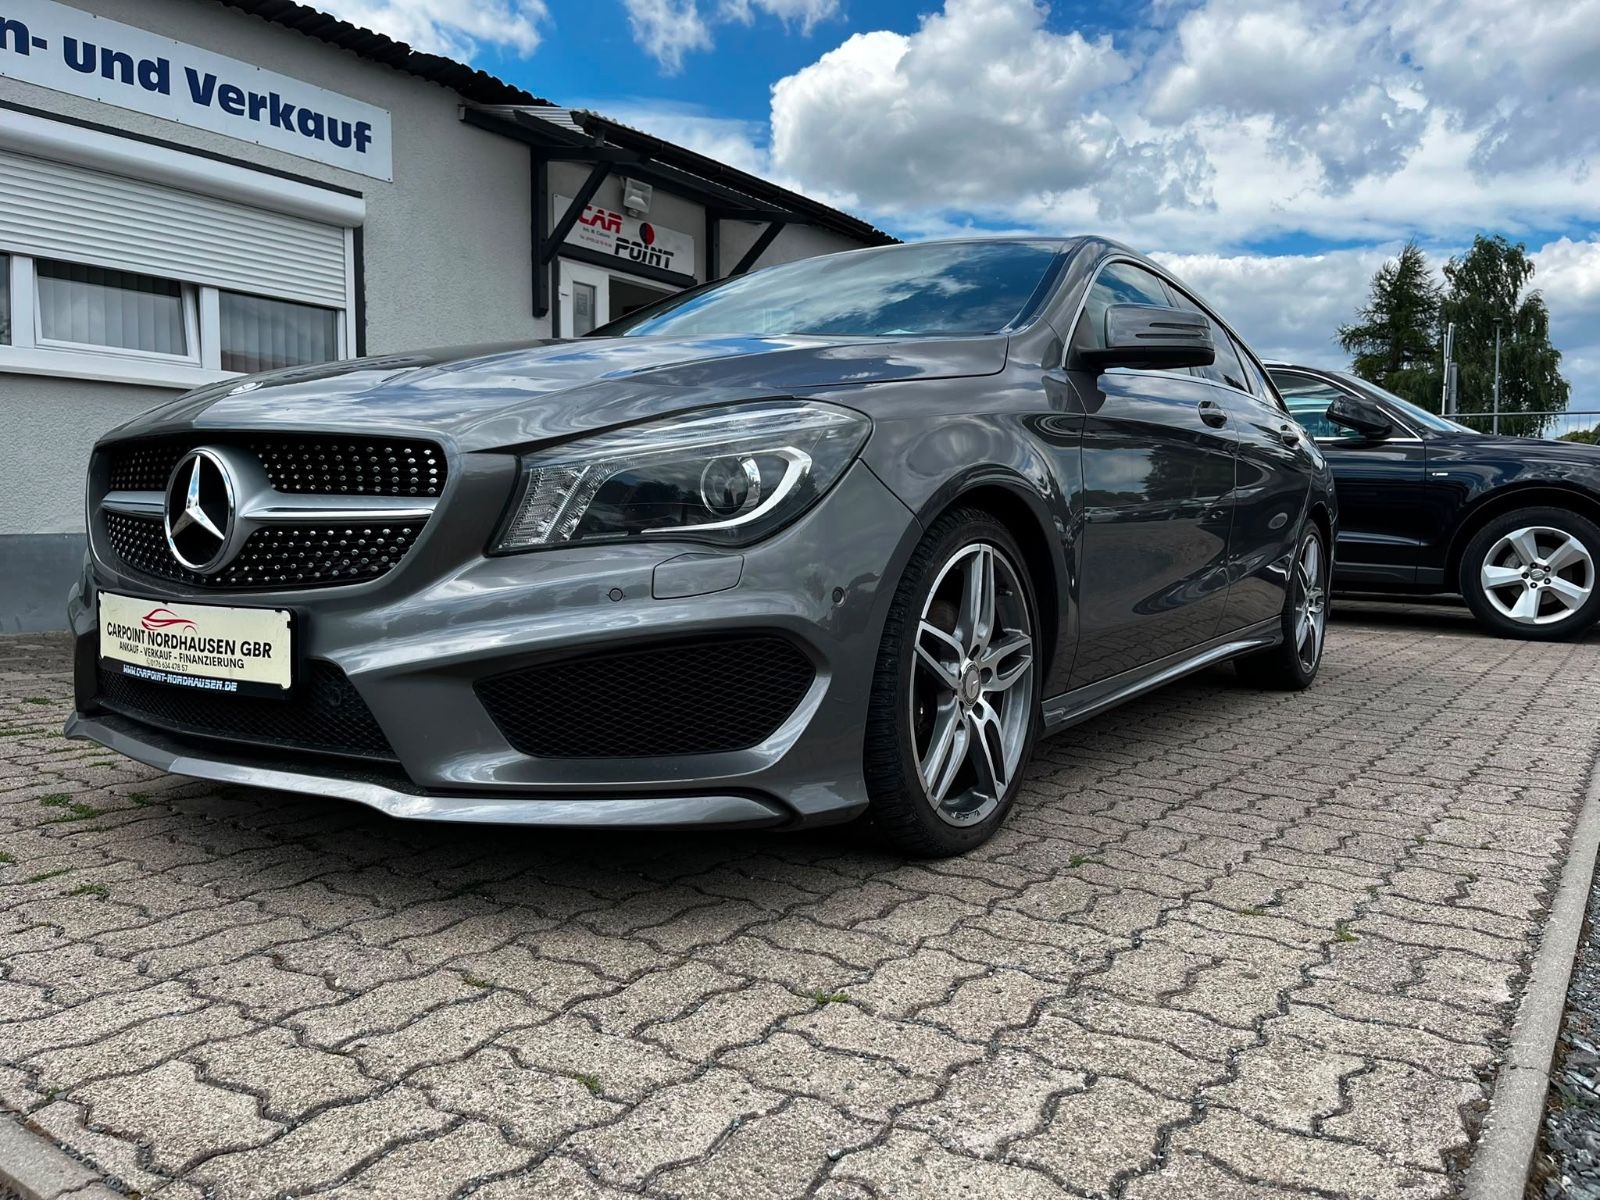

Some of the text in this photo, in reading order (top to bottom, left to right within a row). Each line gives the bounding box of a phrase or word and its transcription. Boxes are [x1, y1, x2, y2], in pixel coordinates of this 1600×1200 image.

[63, 36, 170, 95] und
[184, 66, 372, 153] Verkauf
[579, 203, 624, 234] CAR
[614, 237, 674, 269] POINT
[107, 622, 272, 659] CARPOINT NORDHAUSEN GBR
[119, 643, 140, 654] ANKAUF
[144, 647, 172, 661] VERKAUF
[179, 653, 245, 669] FINANZIERUNG
[123, 664, 237, 692] WWW.CARPOINT-NORDHAUSEN.DE
